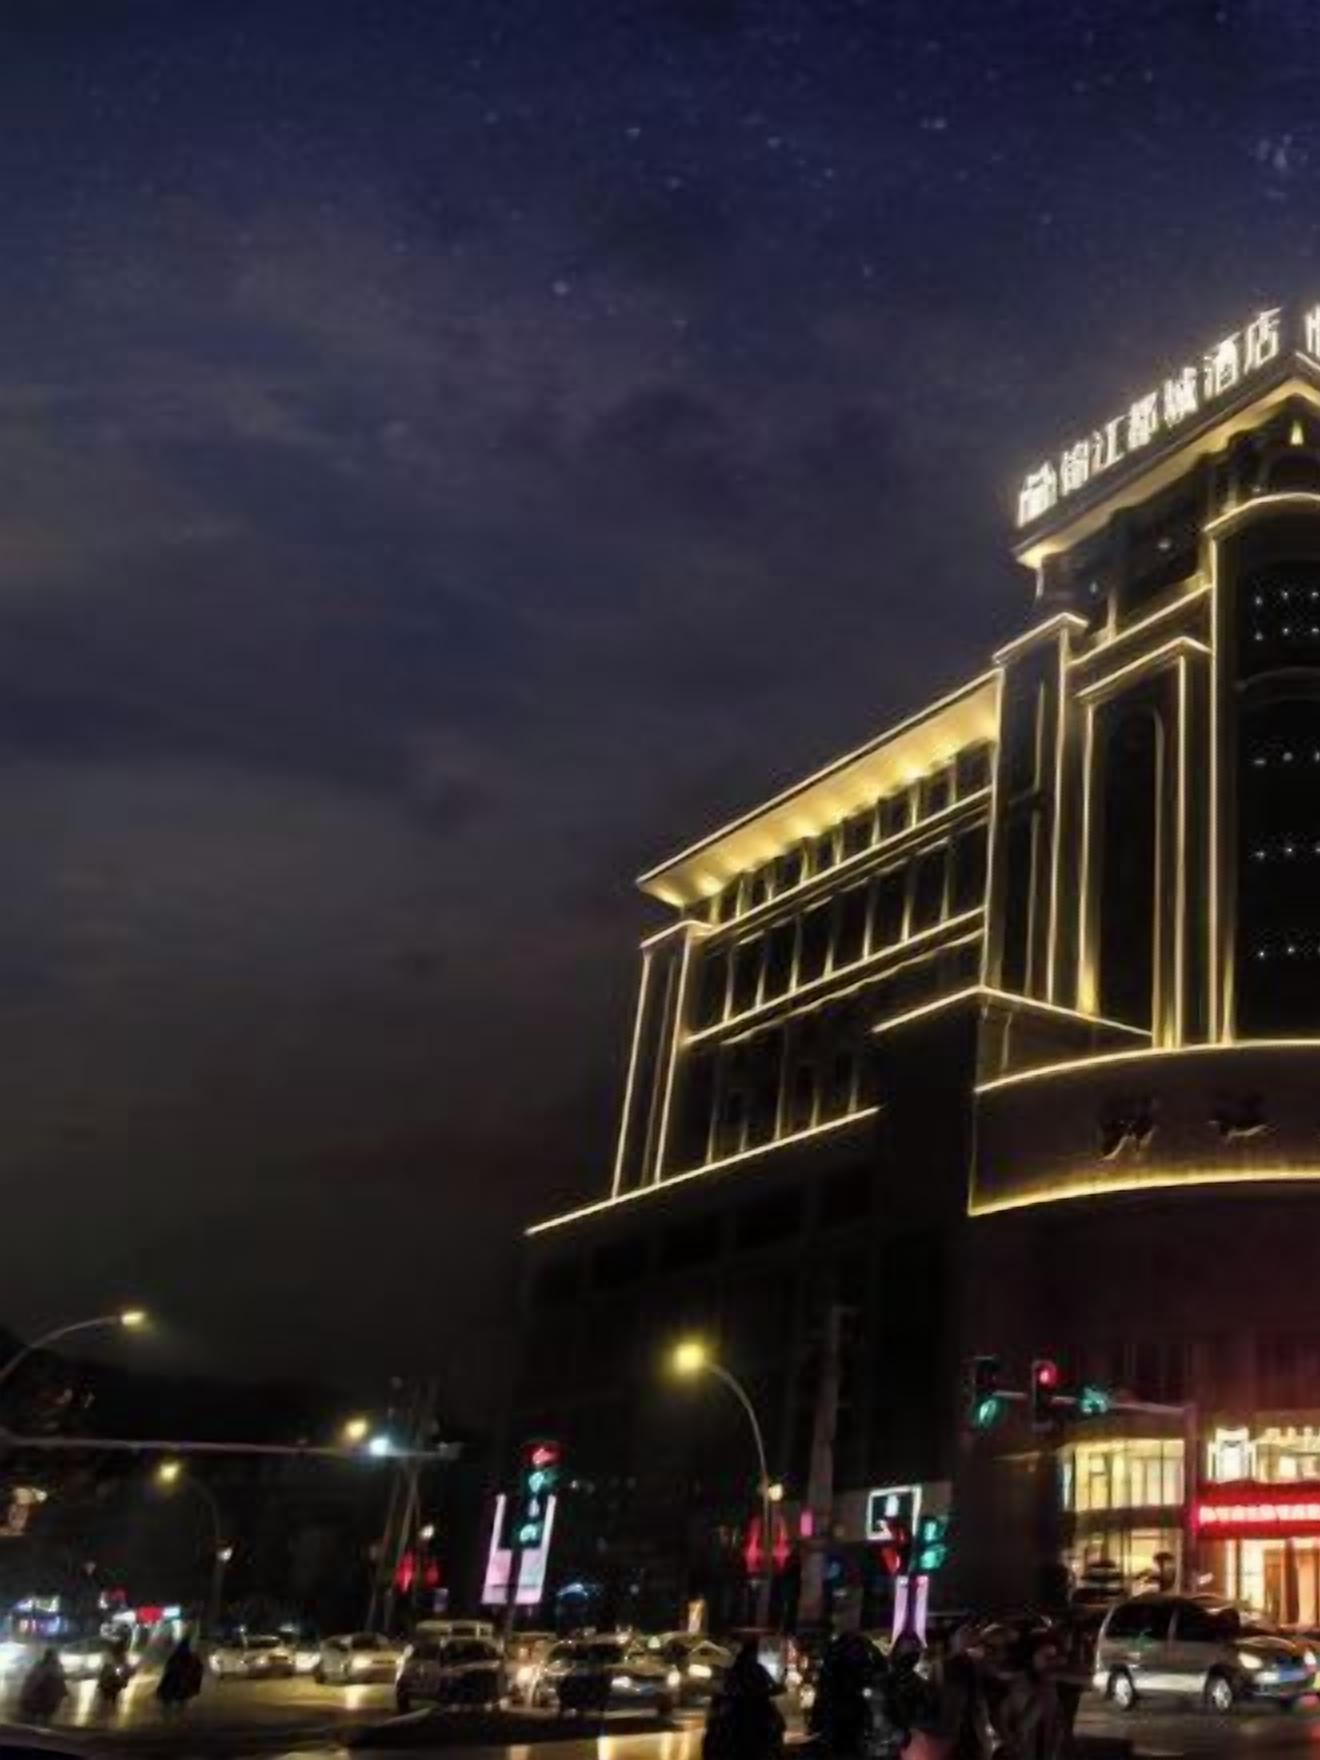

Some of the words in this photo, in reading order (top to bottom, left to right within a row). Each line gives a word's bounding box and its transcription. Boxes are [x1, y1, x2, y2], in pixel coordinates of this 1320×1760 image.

[1060, 307, 1283, 497] 锦江都城酒店
